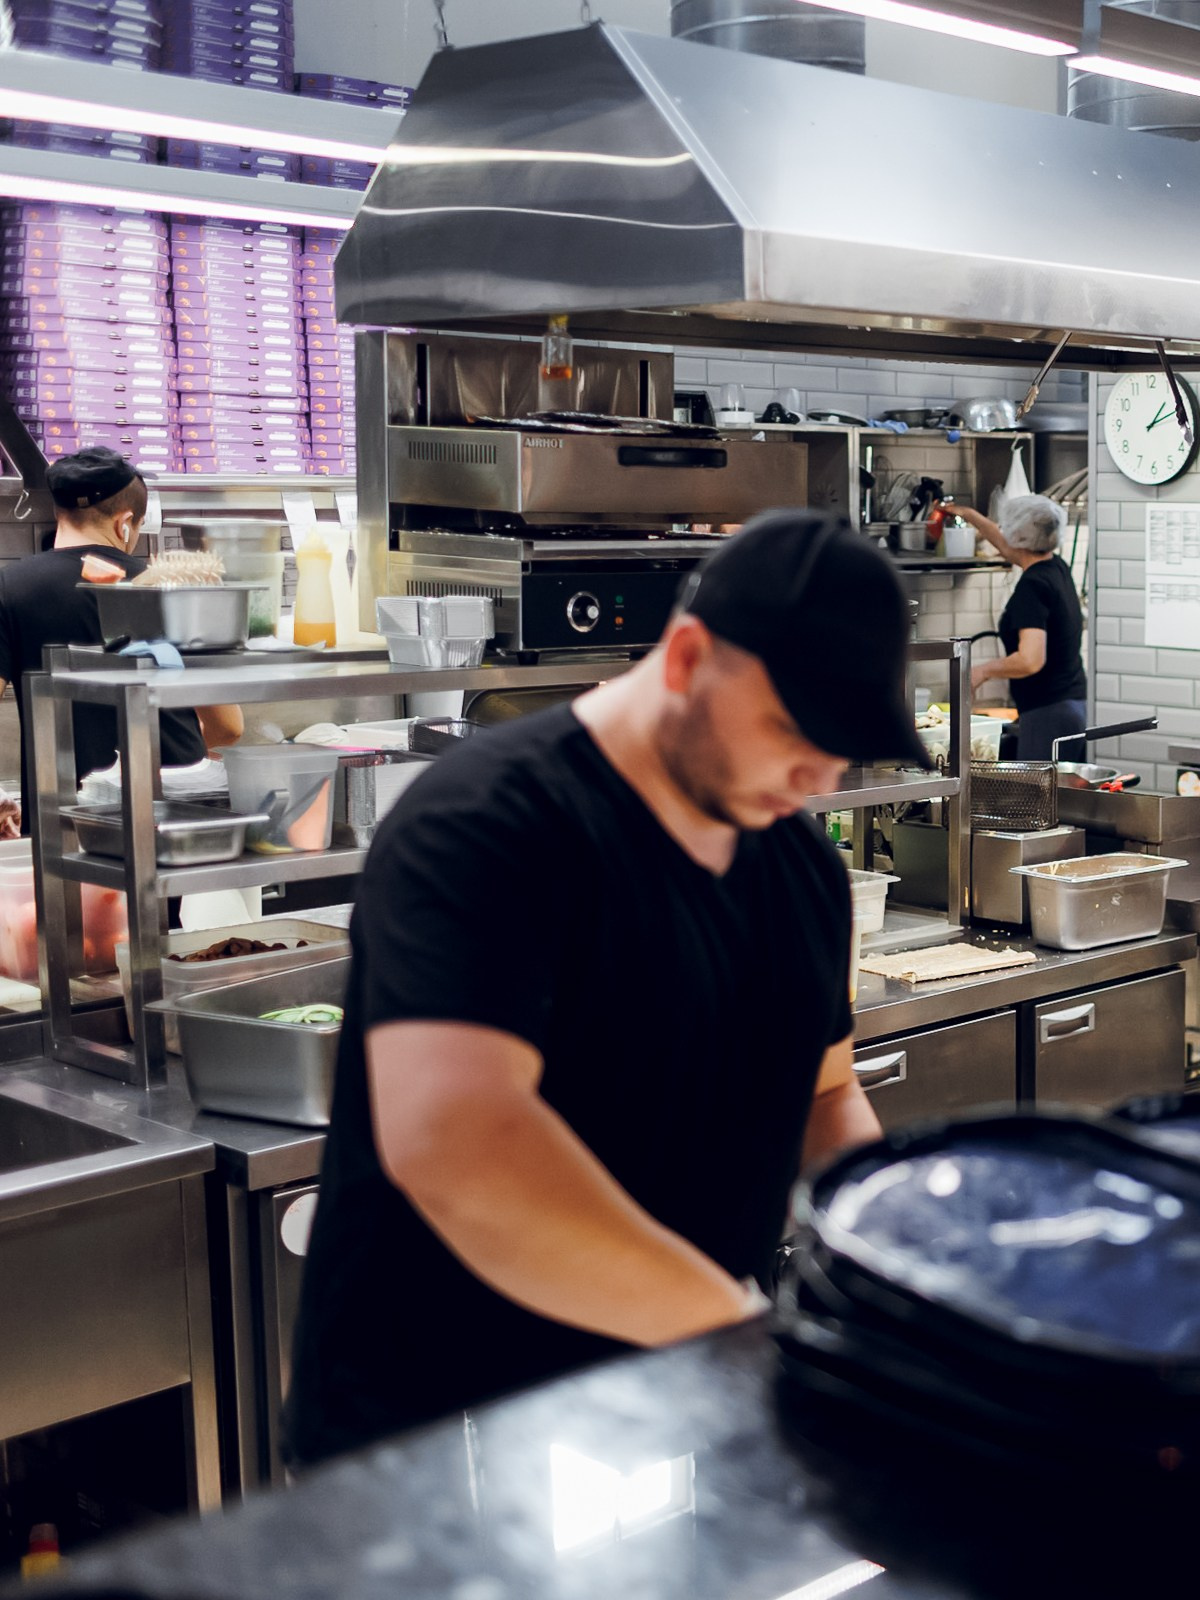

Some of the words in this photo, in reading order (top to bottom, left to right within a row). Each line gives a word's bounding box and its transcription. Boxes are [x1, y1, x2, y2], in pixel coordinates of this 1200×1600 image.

[1146, 374, 1156, 389] 12
[1131, 382, 1140, 396] 11
[1120, 398, 1131, 412] 10
[1115, 418, 1122, 432] 9
[524, 437, 564, 449] AIRHOT
[1122, 439, 1129, 454] 8
[1178, 441, 1185, 452] 4
[1136, 455, 1143, 469] 7
[1151, 461, 1158, 475] 6
[1167, 455, 1174, 470] 5
